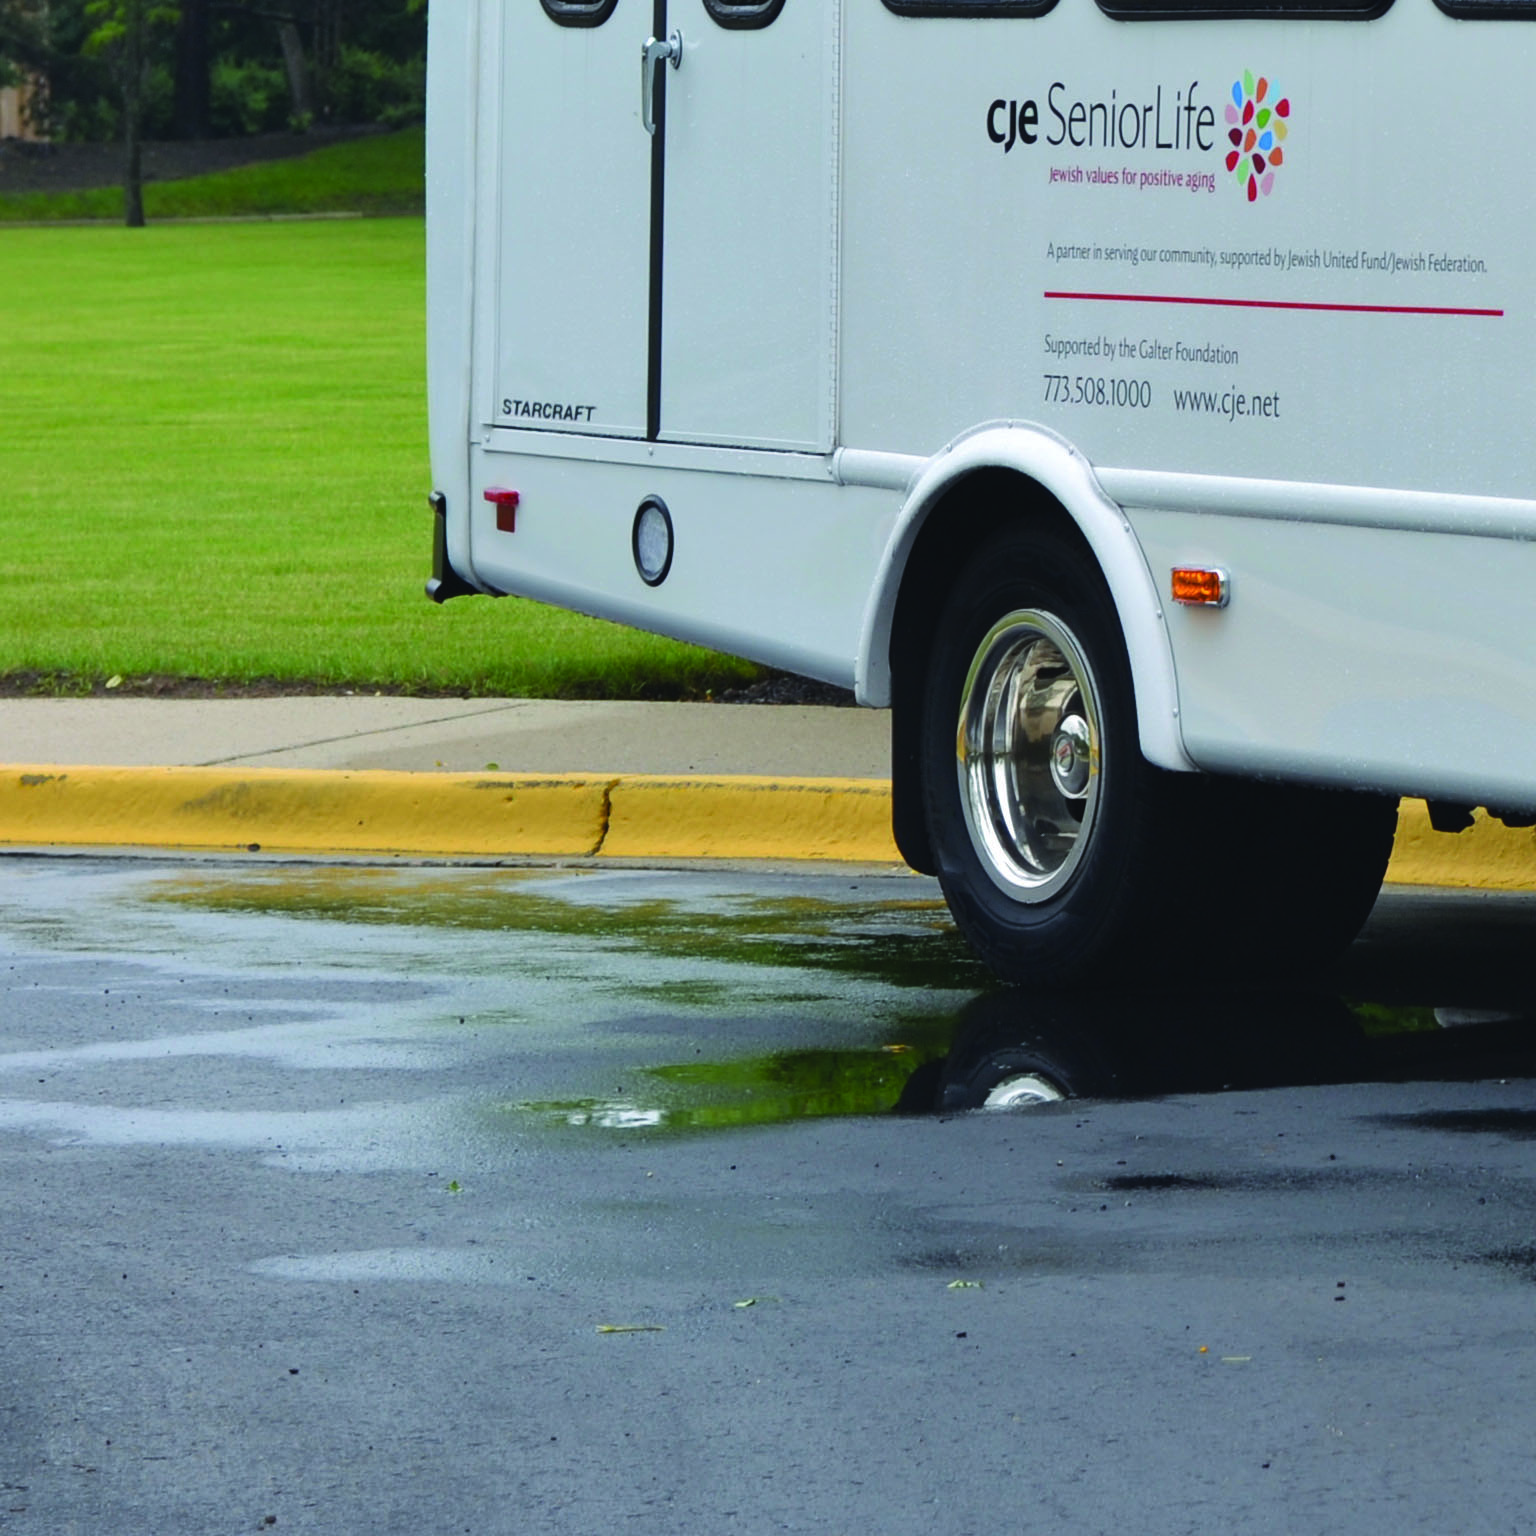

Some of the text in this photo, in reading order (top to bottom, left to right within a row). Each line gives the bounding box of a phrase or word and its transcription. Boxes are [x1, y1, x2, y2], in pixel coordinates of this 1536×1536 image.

[987, 81, 1215, 154] cje SeniorLife
[1048, 166, 1215, 193] Jewish values for positive aging
[1047, 243, 1487, 274] A partner in serving our community, supported by Jewish United Fund/Jewish Federation.
[1044, 334, 1238, 364] Supported by the Galter Foundation
[502, 398, 597, 422] STARCRAFT
[1043, 374, 1280, 422] 773.508.1000 www.cje.net
